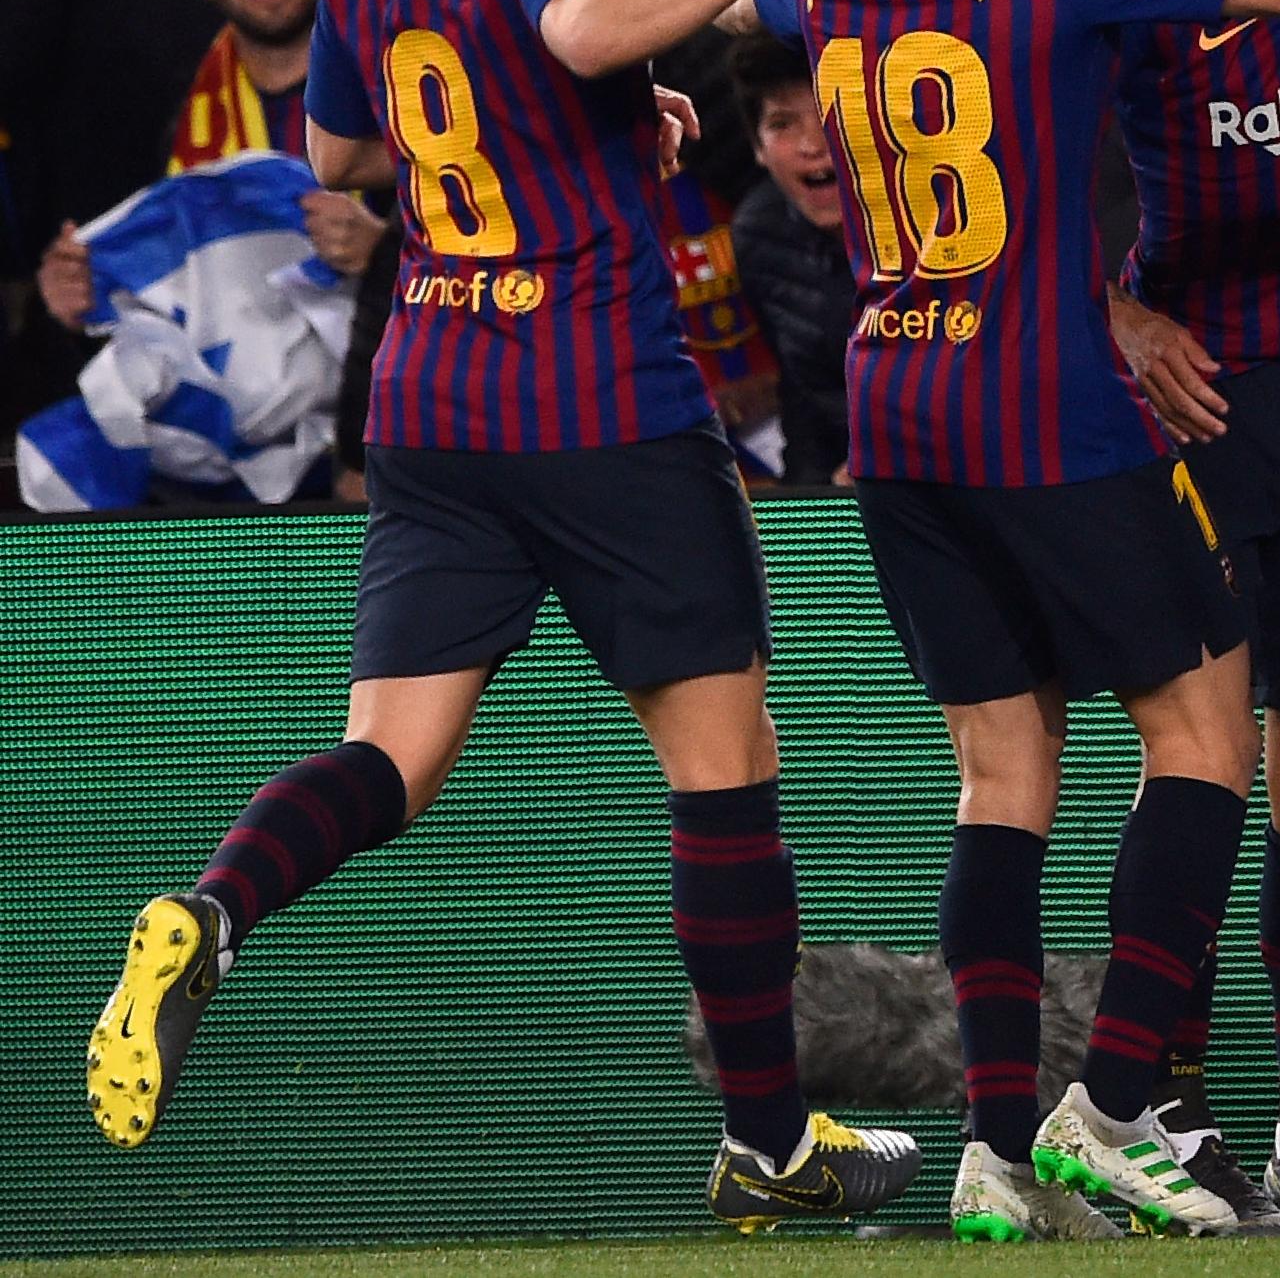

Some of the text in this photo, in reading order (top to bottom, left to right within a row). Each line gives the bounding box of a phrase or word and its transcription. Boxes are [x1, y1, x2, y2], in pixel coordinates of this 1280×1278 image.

[382, 27, 518, 258] 8
[816, 29, 1008, 282] 18
[856, 299, 941, 340] nicef
